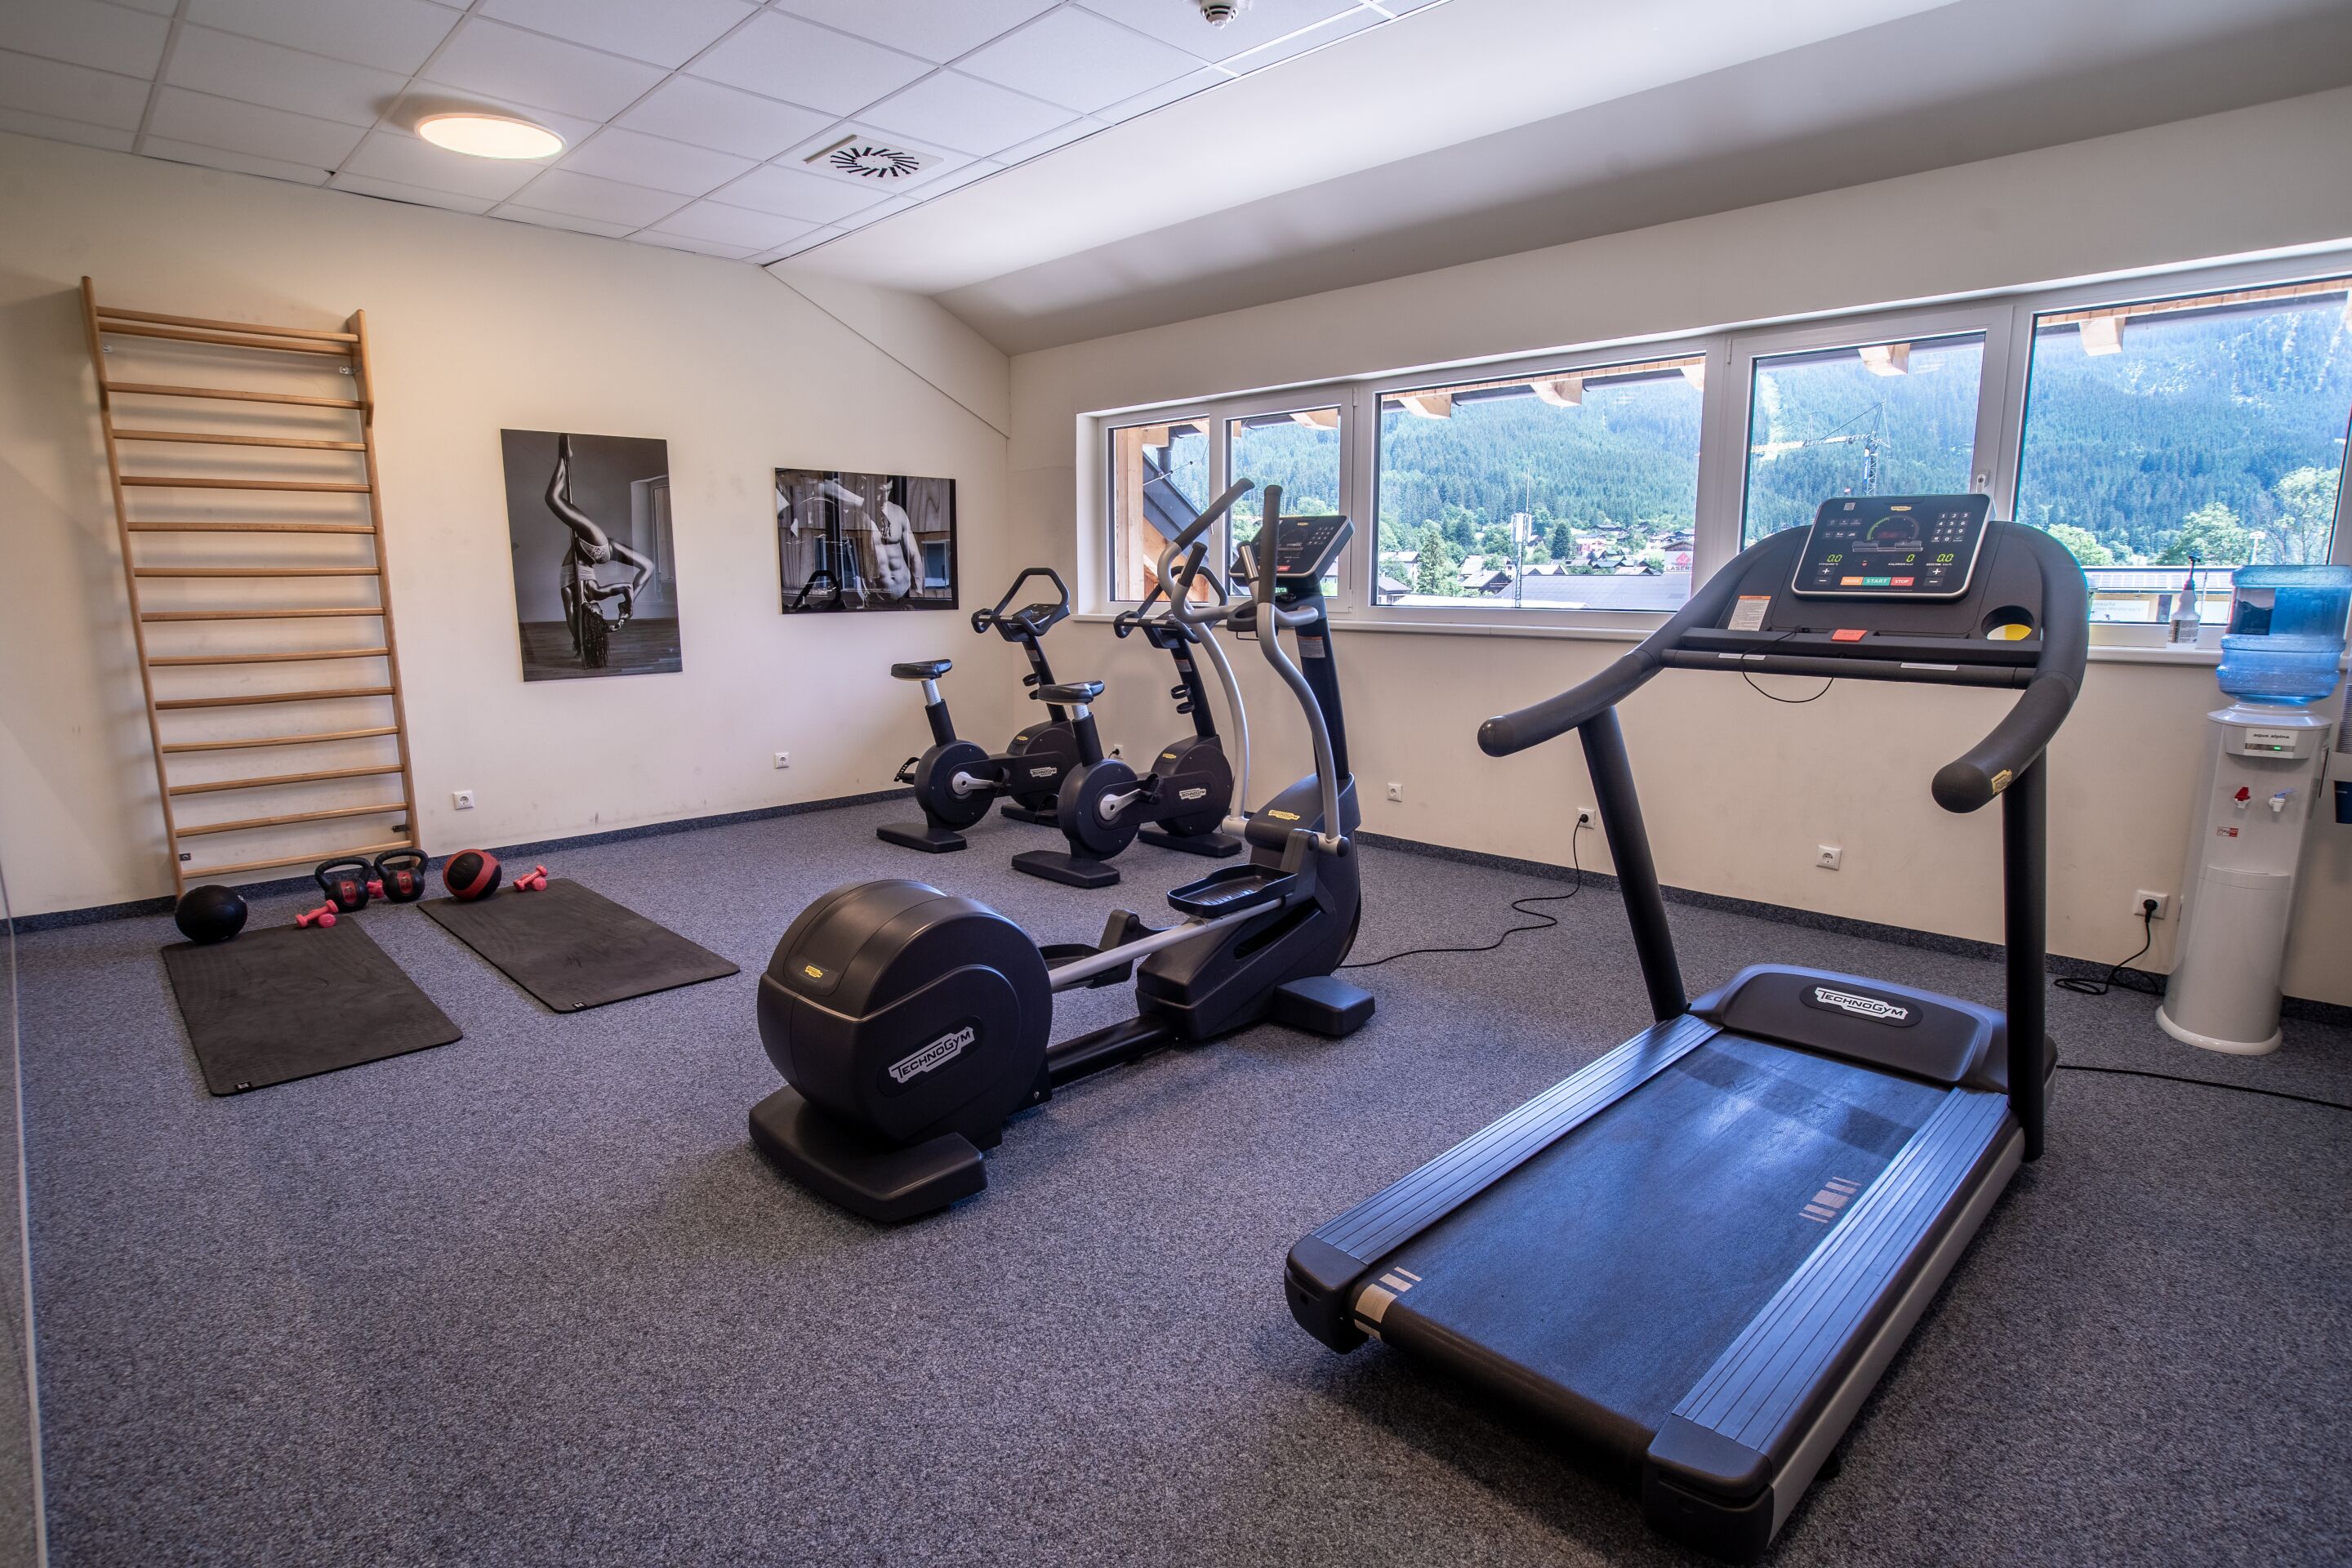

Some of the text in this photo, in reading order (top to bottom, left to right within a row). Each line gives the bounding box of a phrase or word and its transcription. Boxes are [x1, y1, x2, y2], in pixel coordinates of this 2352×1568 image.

[1906, 554, 1915, 563] 0
[1818, 989, 1904, 1017] TECHNOGYM
[891, 1031, 972, 1079] TECHNOGYM
